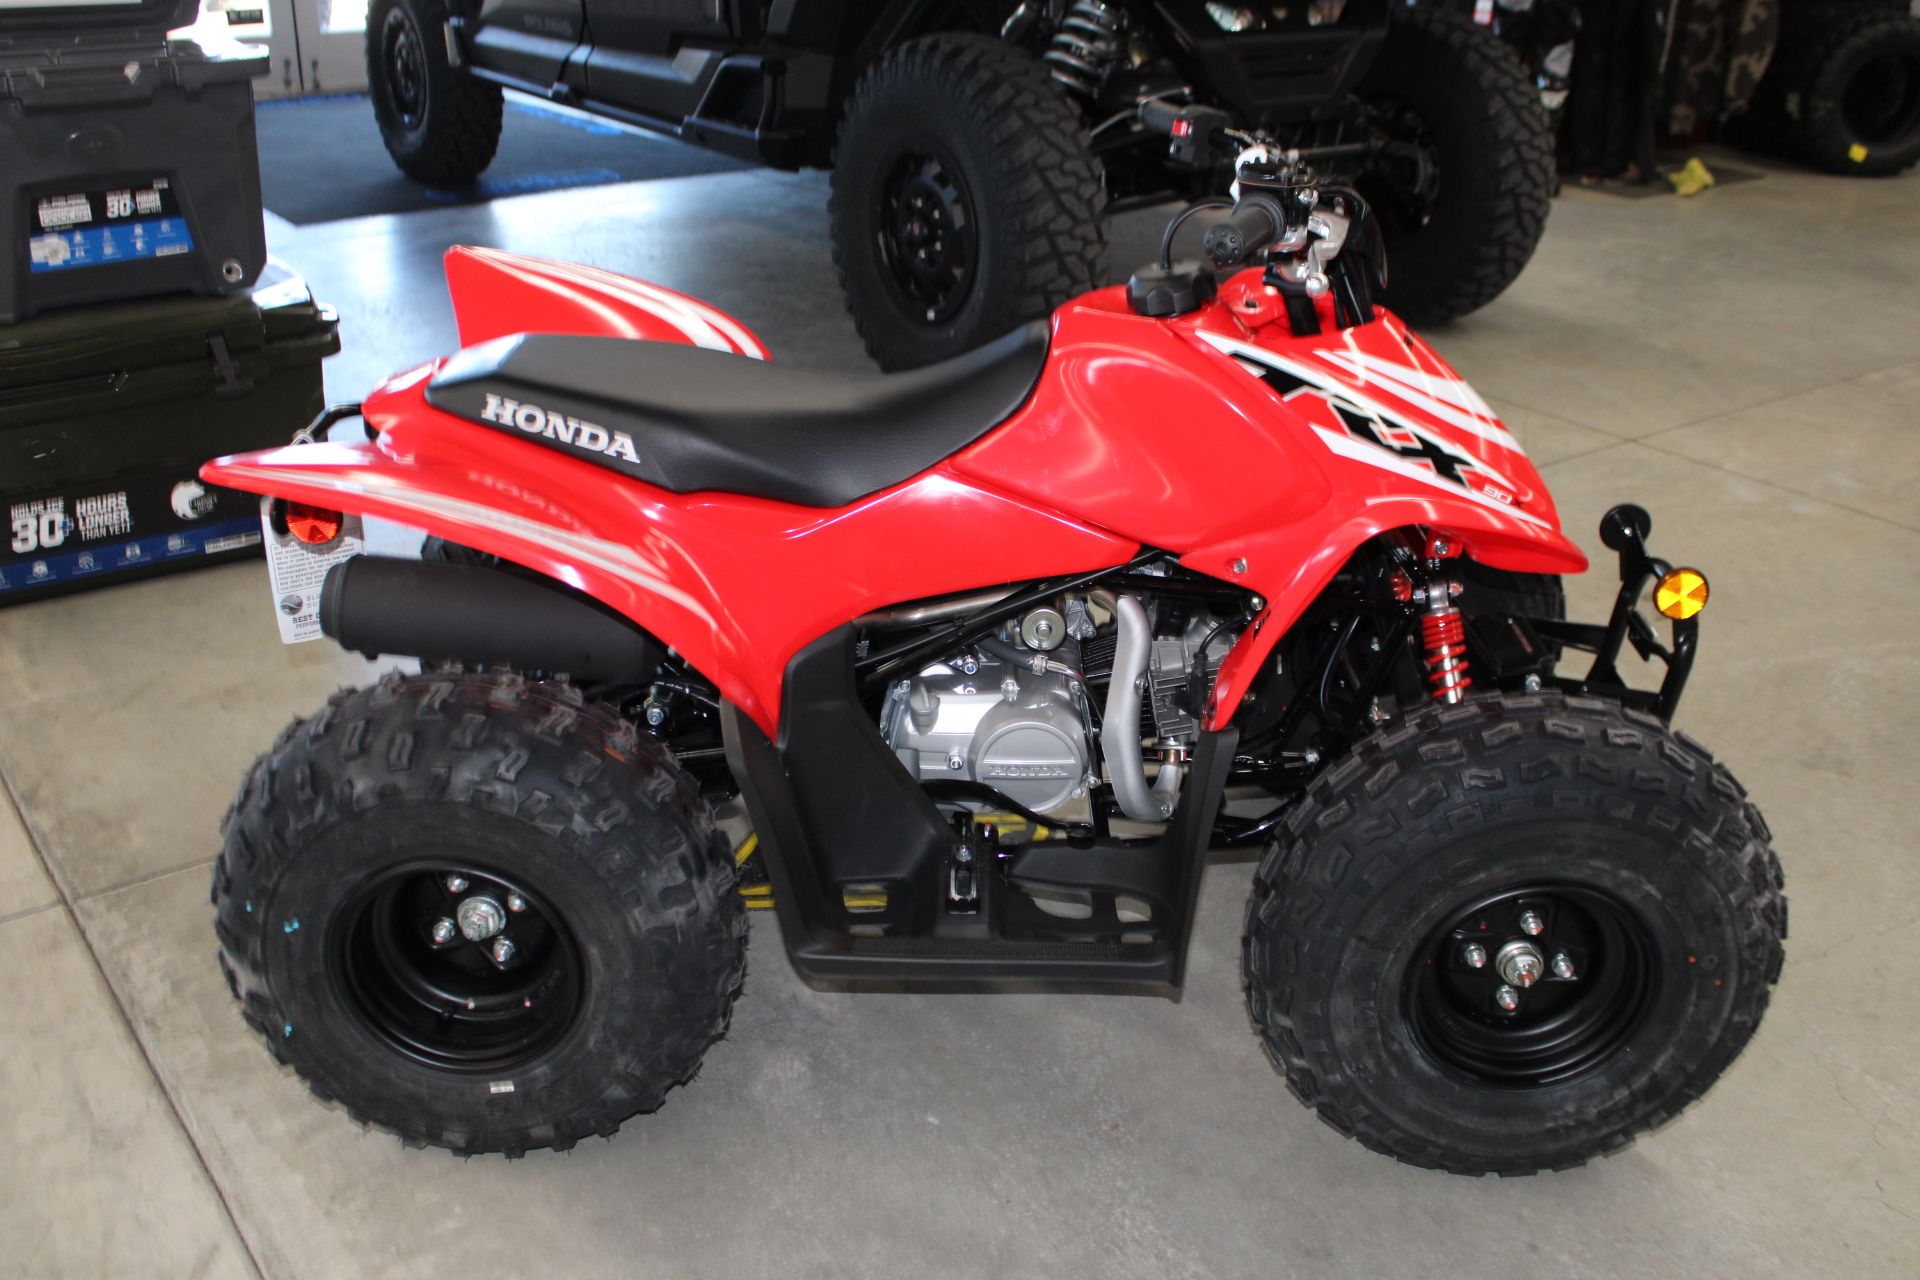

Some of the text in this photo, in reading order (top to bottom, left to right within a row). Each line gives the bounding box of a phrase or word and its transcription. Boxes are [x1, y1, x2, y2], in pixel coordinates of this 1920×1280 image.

[481, 393, 641, 464] HONDA
[76, 491, 127, 518] HOURS
[1483, 483, 1513, 504] 90
[11, 496, 64, 520] HOLDS ICE
[79, 506, 130, 531] LONGER
[81, 523, 131, 541] THAN YETI
[293, 613, 313, 624] BEST
[989, 766, 1069, 776] HONDA
